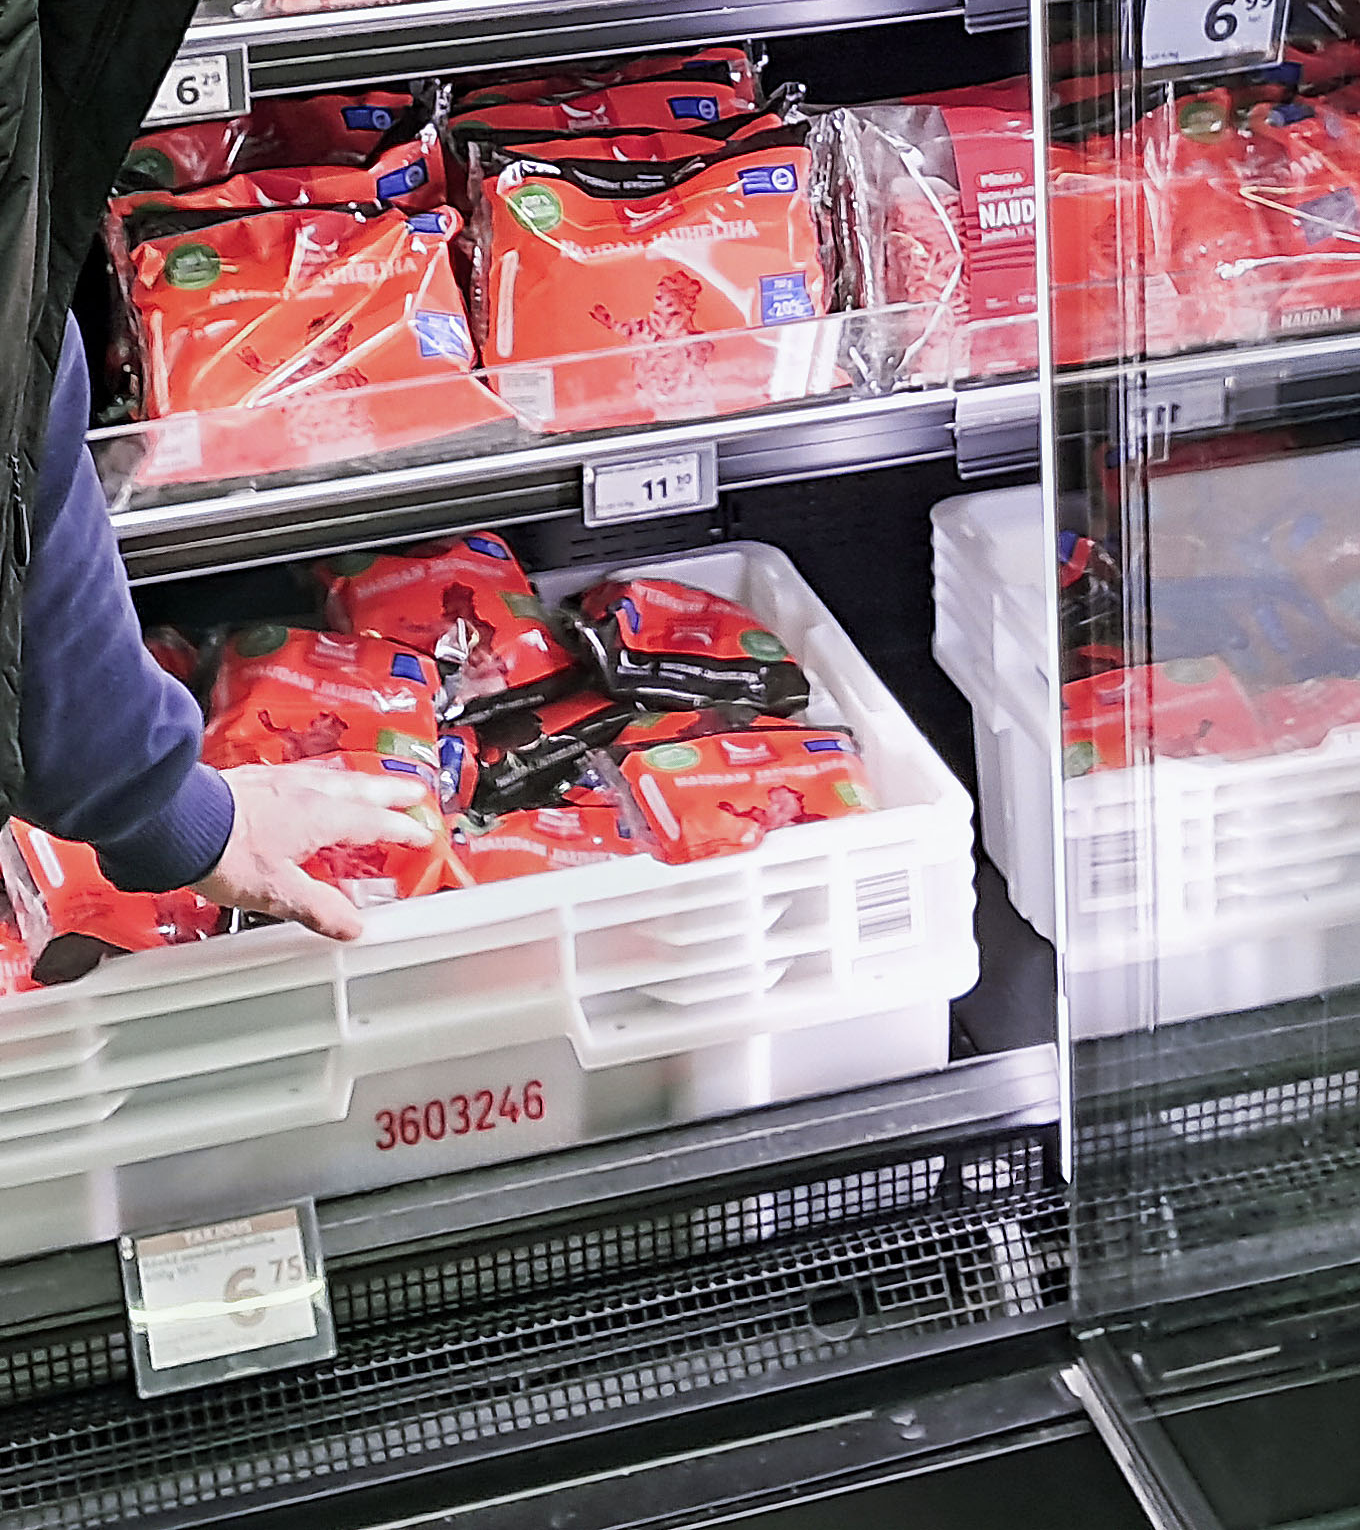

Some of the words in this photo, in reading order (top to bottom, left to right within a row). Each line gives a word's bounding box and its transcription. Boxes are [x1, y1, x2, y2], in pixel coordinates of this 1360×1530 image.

[176, 76, 200, 106] 6
[978, 197, 1035, 230] NAUD
[641, 477, 668, 501] 11
[371, 1078, 547, 1152] 3603246
[268, 1254, 303, 1284] 75
